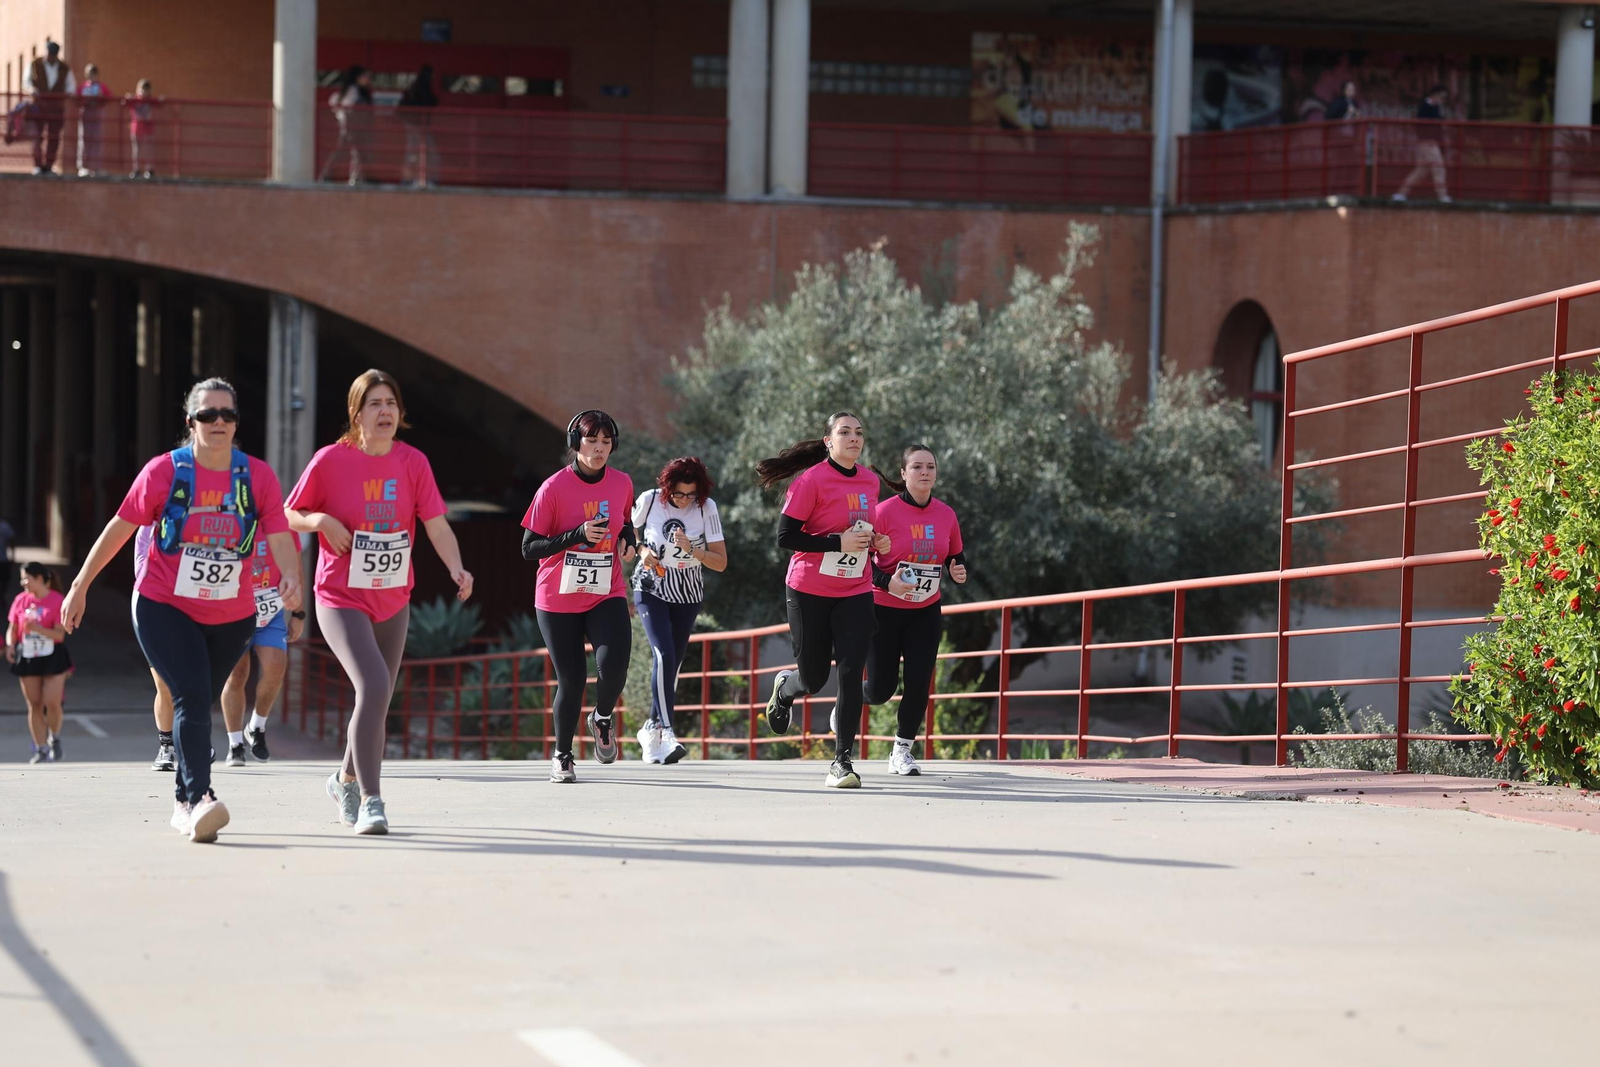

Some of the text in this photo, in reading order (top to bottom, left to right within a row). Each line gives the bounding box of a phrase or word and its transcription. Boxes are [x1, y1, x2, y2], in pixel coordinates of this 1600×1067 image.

[363, 479, 397, 501] WE
[583, 500, 609, 518] WE
[847, 493, 868, 509] WE
[368, 504, 393, 519] RUN
[203, 517, 232, 533] RUN
[910, 524, 934, 539] WE
[187, 547, 216, 559] UMA
[356, 540, 385, 550] UMA
[914, 541, 934, 552] RUN
[362, 552, 402, 572] 599
[567, 558, 589, 566] UMA
[190, 561, 234, 584] 582
[576, 568, 599, 585] 51
